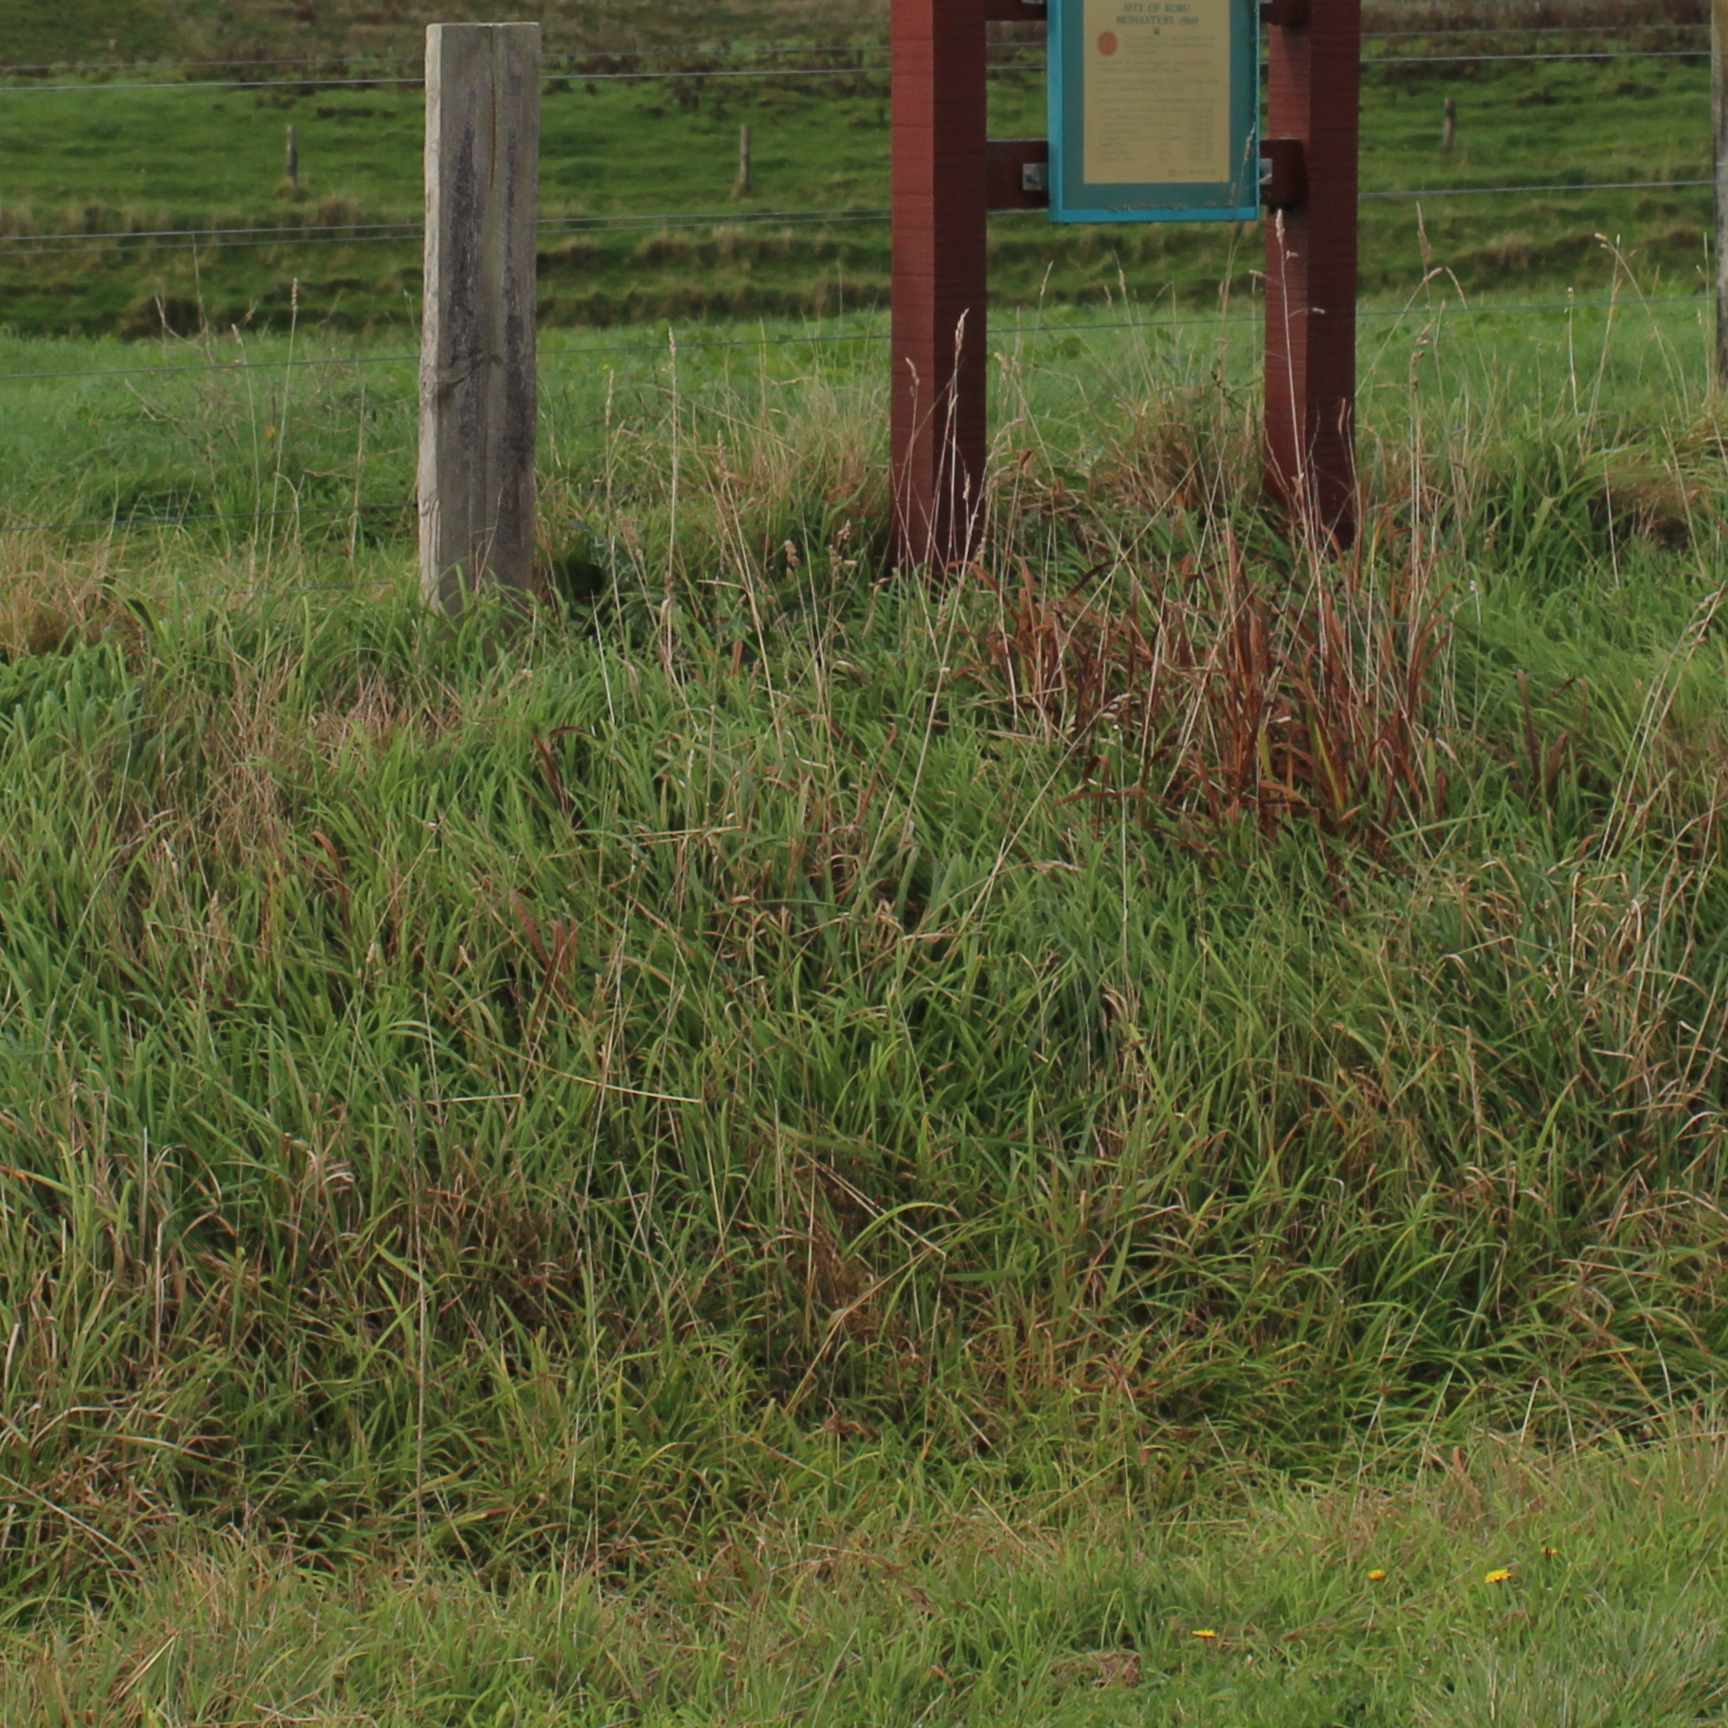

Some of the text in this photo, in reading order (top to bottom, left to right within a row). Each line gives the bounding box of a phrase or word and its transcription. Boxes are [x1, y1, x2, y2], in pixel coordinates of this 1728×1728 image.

[1123, 3, 1143, 13] SITE
[1147, 3, 1160, 13] OF
[1116, 15, 1174, 25] MONASTERY
